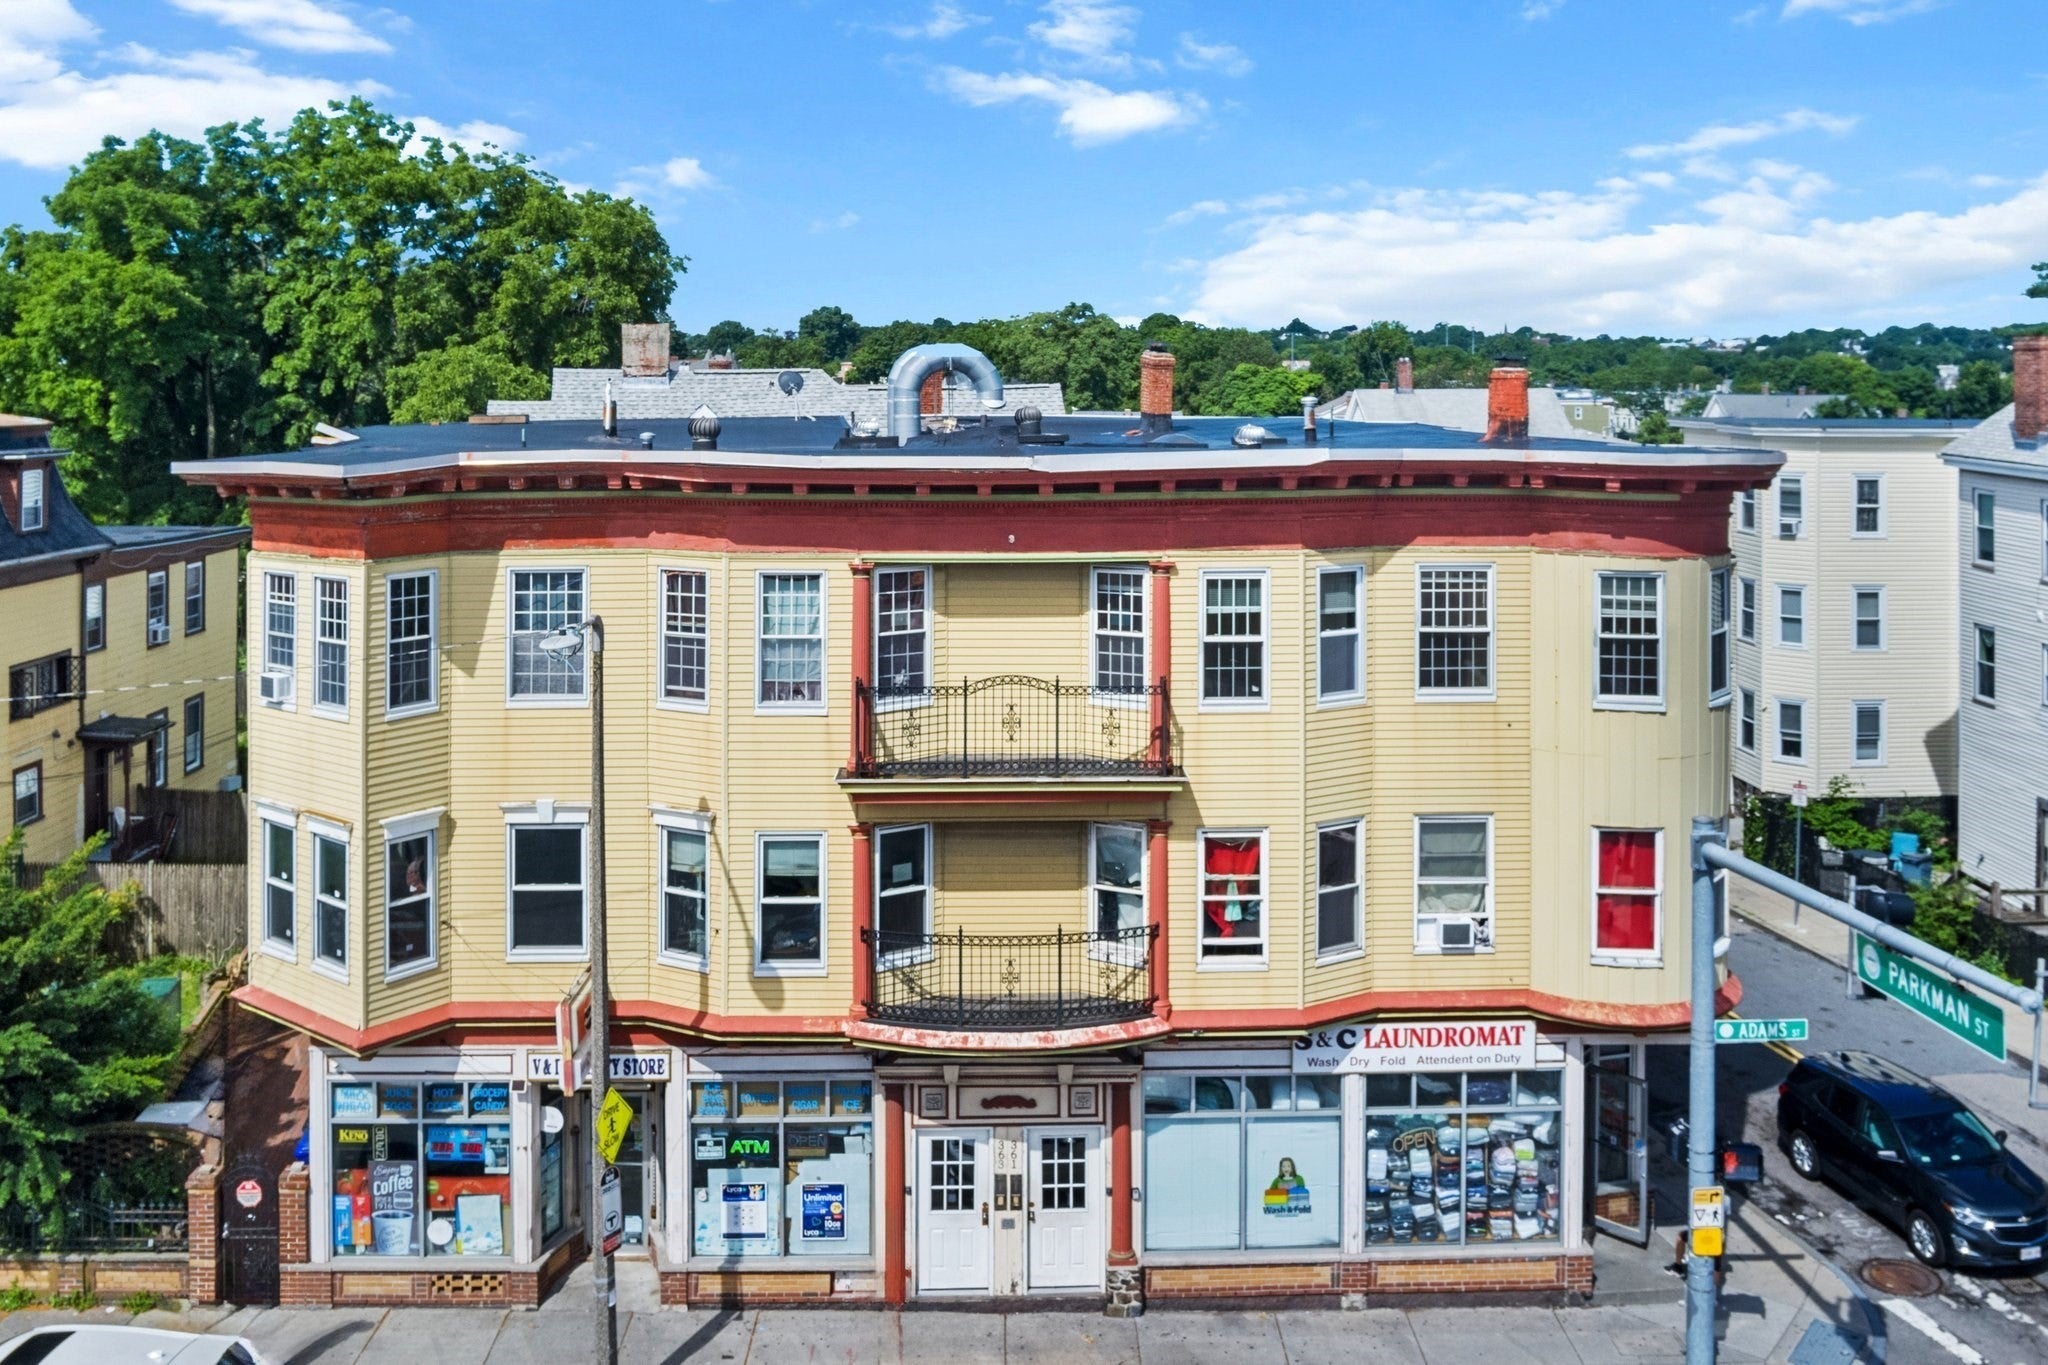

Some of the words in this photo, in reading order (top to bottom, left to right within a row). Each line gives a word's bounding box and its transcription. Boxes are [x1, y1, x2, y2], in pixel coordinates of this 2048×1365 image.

[1888, 961, 1970, 1028] PARKMAN
[1974, 1017, 1989, 1039] ST
[1739, 1022, 1787, 1038] ADAMS
[1791, 1028, 1800, 1038] ST
[1294, 1033, 1313, 1050] S
[1316, 1031, 1333, 1048] &
[1336, 1028, 1357, 1049] C
[1364, 1025, 1525, 1049] LAUNDROMAT
[533, 1058, 542, 1075] V
[543, 1058, 551, 1075] &
[623, 1058, 665, 1076] STORE
[1307, 1057, 1339, 1067] Wash
[1349, 1057, 1370, 1068] Dry
[1380, 1056, 1406, 1066] Fold
[1416, 1055, 1473, 1065] Attendent
[1476, 1056, 1491, 1064] on
[1494, 1054, 1521, 1065] Duty
[384, 1087, 413, 1097] JUICE
[433, 1088, 455, 1097] HOT
[472, 1087, 508, 1097] GROCERY
[473, 1101, 506, 1111] CANDY
[602, 1102, 620, 1120] DRIVE
[339, 1129, 368, 1142] KENO
[604, 1133, 620, 1150] SLOW
[788, 1135, 826, 1146] OPEN
[1392, 1132, 1436, 1152] OPEN
[730, 1140, 770, 1154] ATM
[373, 1174, 413, 1196] Coffee
[803, 1193, 842, 1202] Unlimited
[1262, 1206, 1285, 1214] Wash
[1294, 1205, 1312, 1214] Fold
[606, 1214, 617, 1228] T
